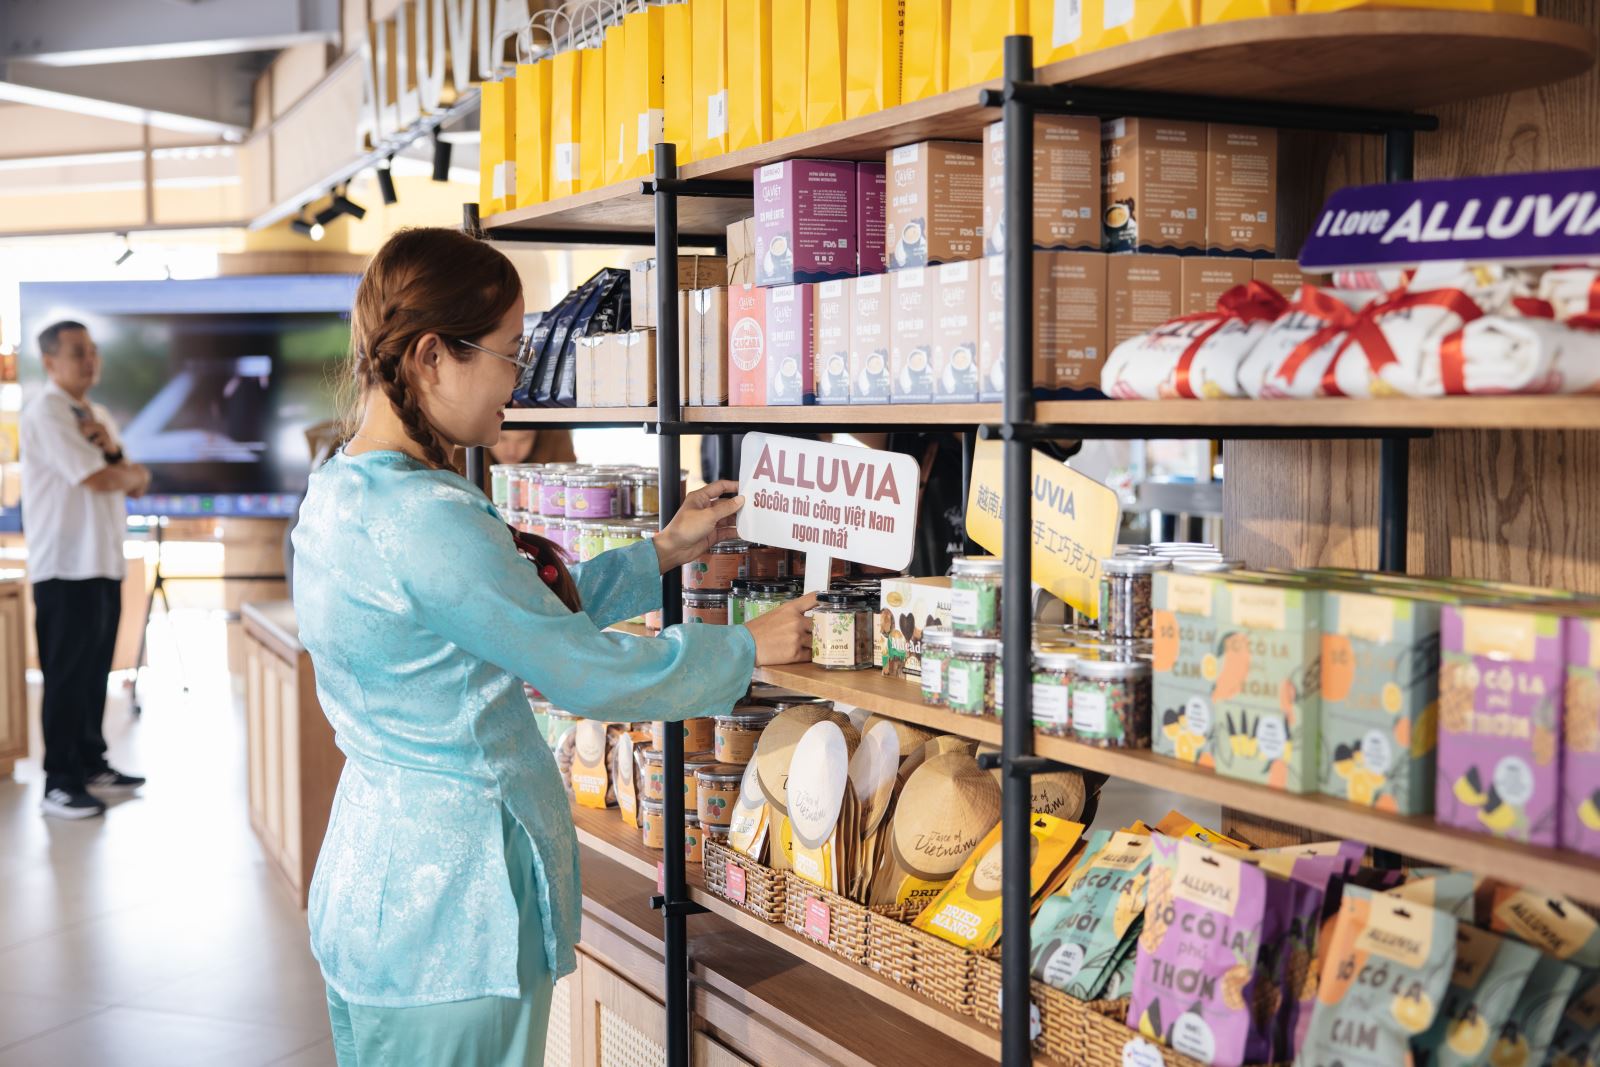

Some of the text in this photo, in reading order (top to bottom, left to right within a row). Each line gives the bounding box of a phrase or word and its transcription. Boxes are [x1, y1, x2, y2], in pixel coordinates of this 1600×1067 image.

[1316, 209, 1334, 237] I
[823, 240, 837, 248] FDA
[753, 443, 900, 504] ALLUVIA
[754, 489, 895, 533] sôcôla thủ công Việt Nam
[792, 523, 848, 549] ngon nhất
[914, 834, 978, 858] Vietnam
[1110, 876, 1135, 895] LA
[930, 913, 979, 941] MANGO
[943, 904, 982, 928] DRIED
[1181, 912, 1216, 939] CÔ
[1221, 929, 1247, 954] LA
